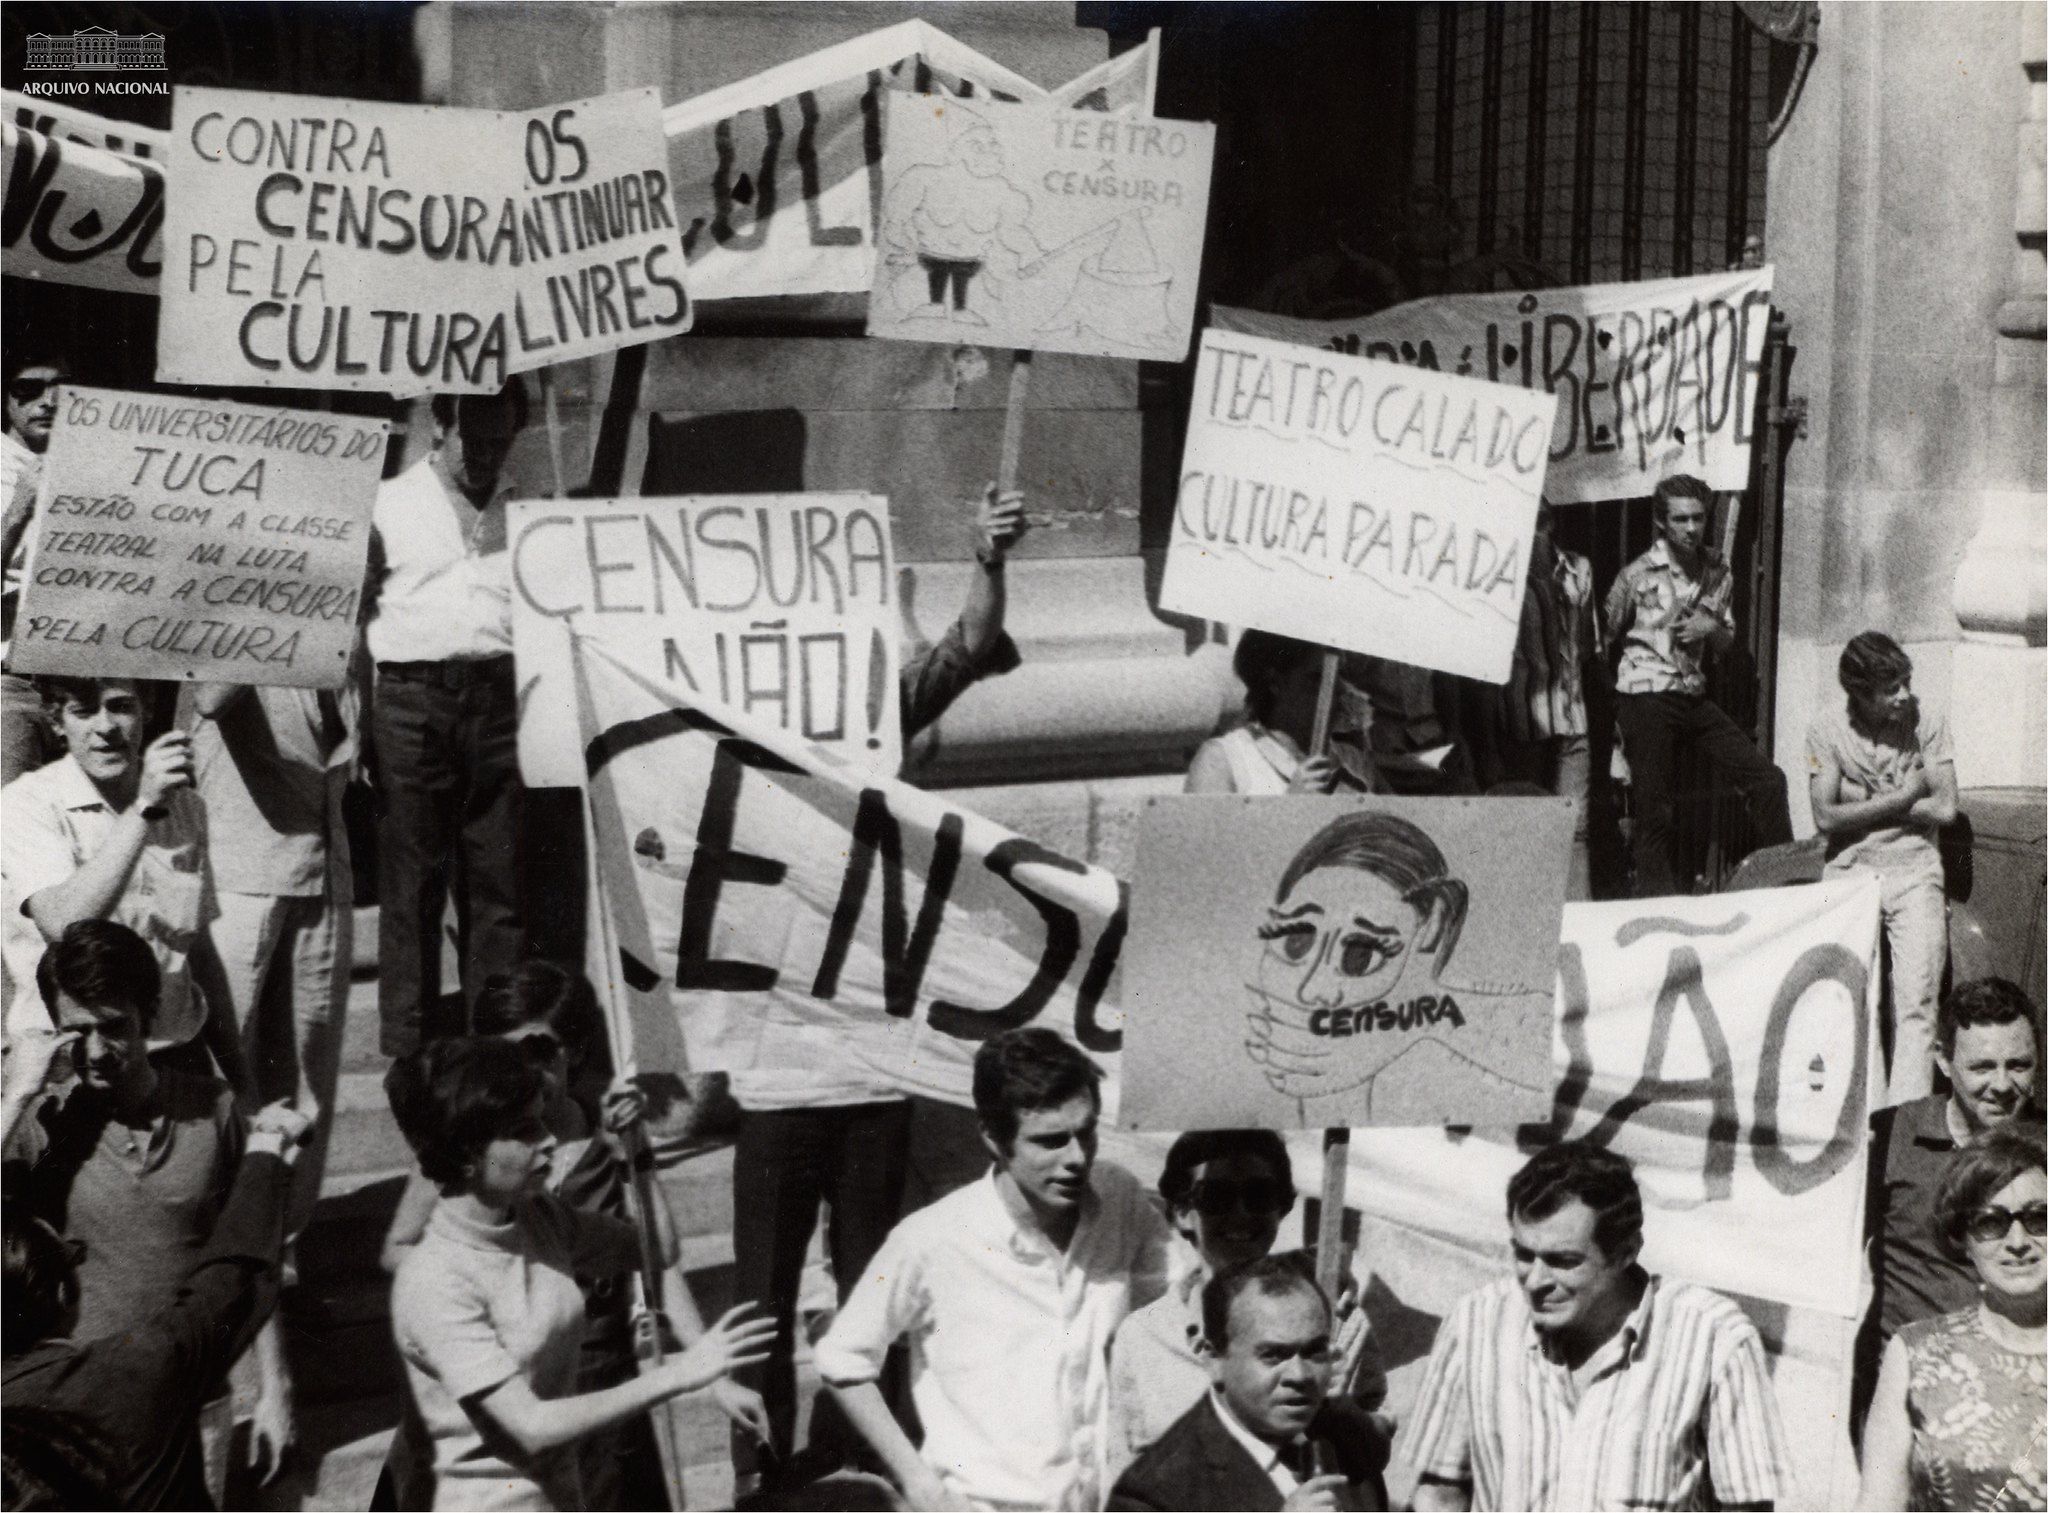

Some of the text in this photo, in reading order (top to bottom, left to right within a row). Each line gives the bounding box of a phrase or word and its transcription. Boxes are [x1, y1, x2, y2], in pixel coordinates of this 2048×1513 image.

[190, 111, 390, 178] CONTRA
[1053, 119, 1187, 158] TEATRO
[1043, 170, 1183, 206] CENSURA
[255, 173, 520, 266] CENSURA
[188, 234, 327, 302] PELA
[515, 244, 688, 351] LIVRES
[238, 302, 508, 385] CULTURA
[108, 399, 338, 457] UNIVERSITÁRIOS
[340, 428, 384, 461] DO
[1205, 345, 1364, 438] TEATRO
[1372, 383, 1546, 475] CALADO
[131, 445, 266, 500] TUCA
[48, 494, 355, 541] ESTÃO COM A CLASSE
[1177, 471, 1518, 598] CULTURA PARADA
[42, 530, 309, 573] TEATRAL NA LUTA
[512, 505, 888, 618] CENSURA
[35, 567, 361, 625] CONTRA A CENSURA
[27, 614, 302, 668] PELA CULTURA
[1308, 995, 1466, 1038] CENSURA
